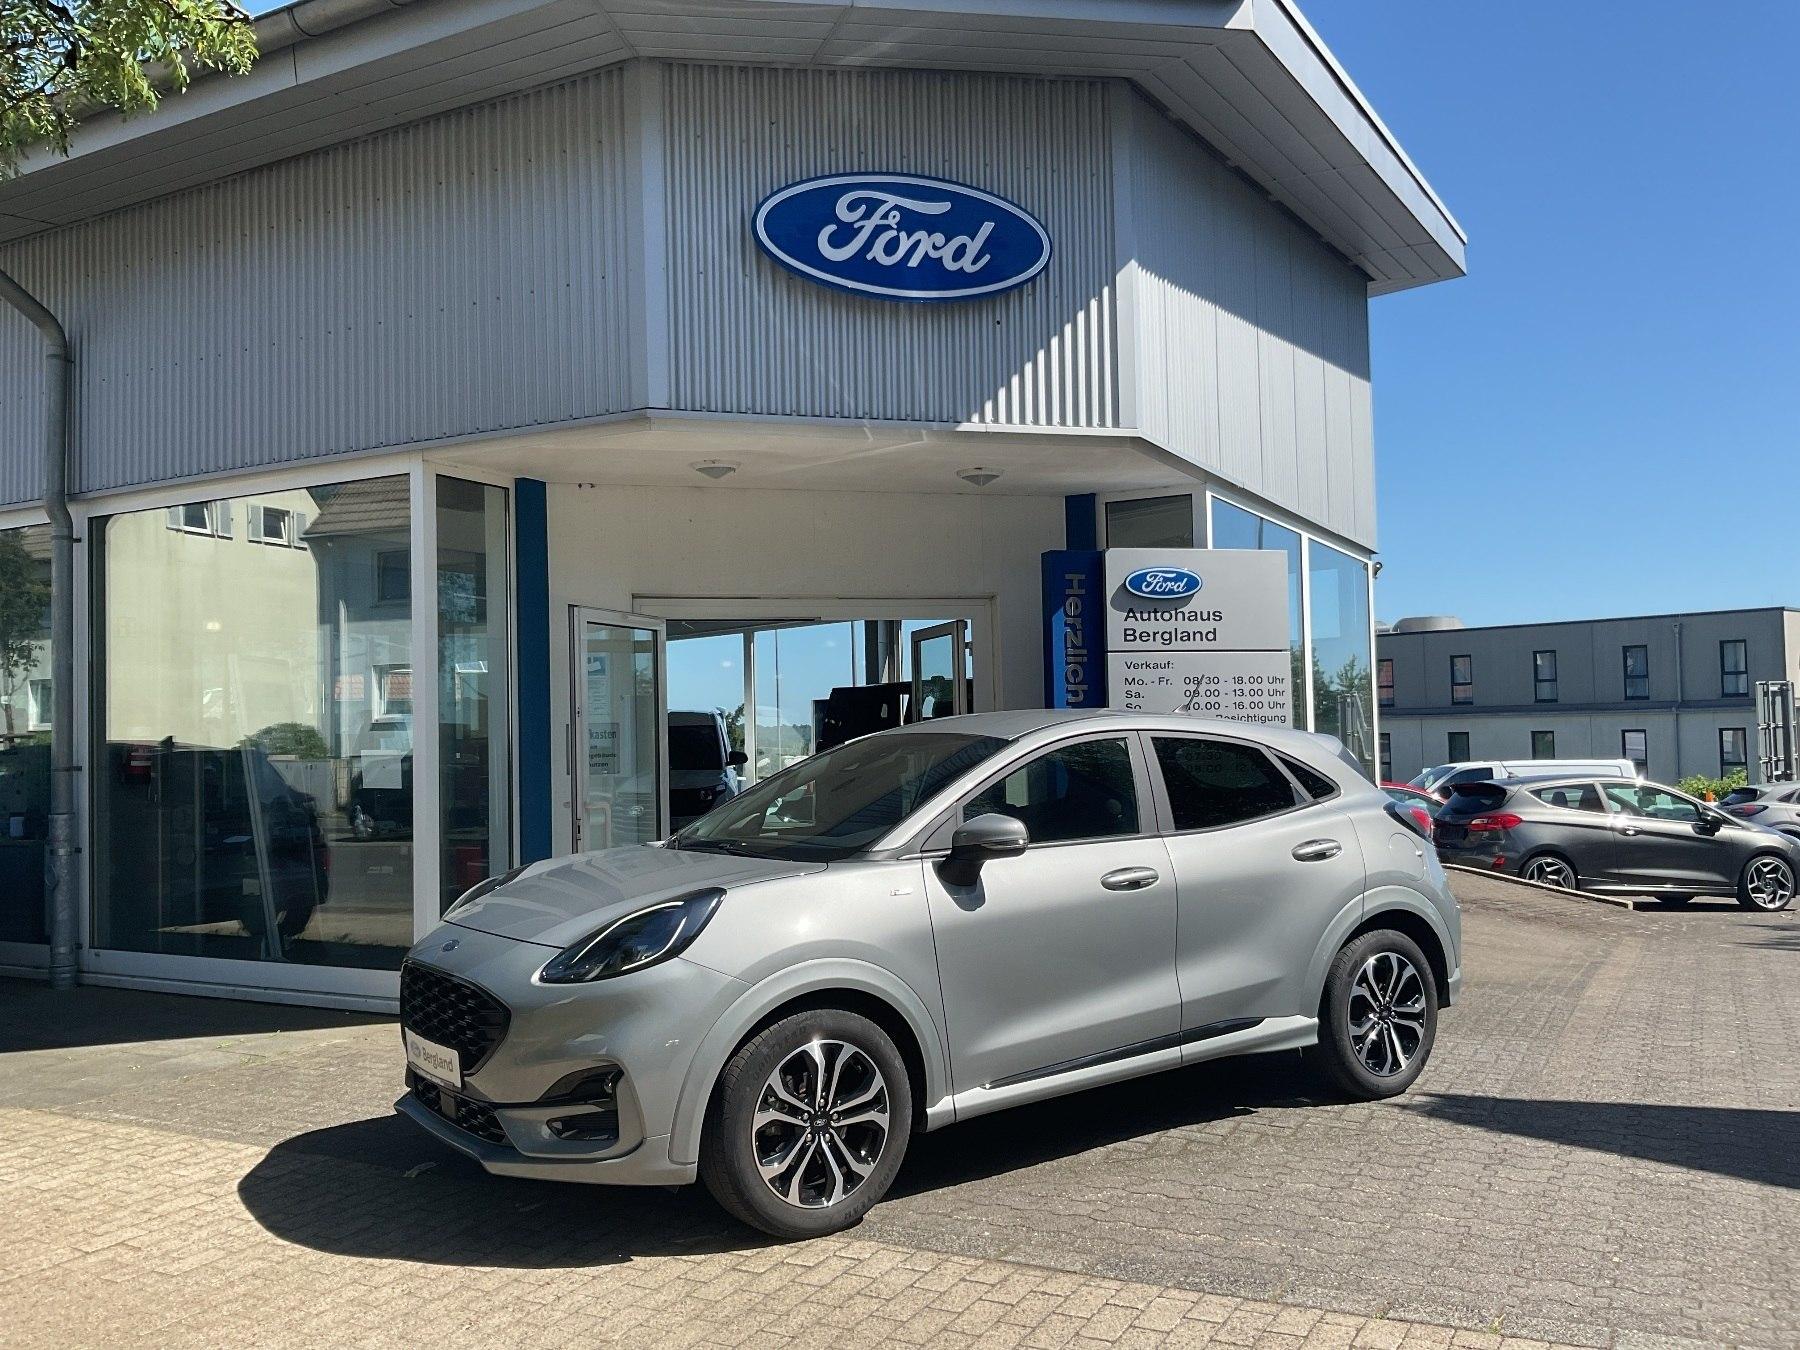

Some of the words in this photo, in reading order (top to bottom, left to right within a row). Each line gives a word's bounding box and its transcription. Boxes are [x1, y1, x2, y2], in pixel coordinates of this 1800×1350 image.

[817, 190, 995, 274] Ford
[1141, 572, 1188, 592] Ford
[1123, 607, 1223, 622] Autohaus
[1064, 574, 1088, 703] Herzlich
[1123, 627, 1217, 646] Bergland
[1124, 660, 1174, 670] Verkauf:
[1124, 677, 1148, 686] Mo.
[1158, 676, 1173, 686] Fr.
[1232, 675, 1263, 685] 18.00
[1267, 675, 1285, 685] Uhr
[1125, 689, 1145, 699] Sa.
[1232, 688, 1264, 697] 13.00
[1267, 688, 1285, 697] Uhr
[1232, 701, 1264, 710] 16.00
[1267, 701, 1286, 710] Uhr
[1216, 714, 1286, 724] sichtigung
[422, 1046, 453, 1072] Bergland
